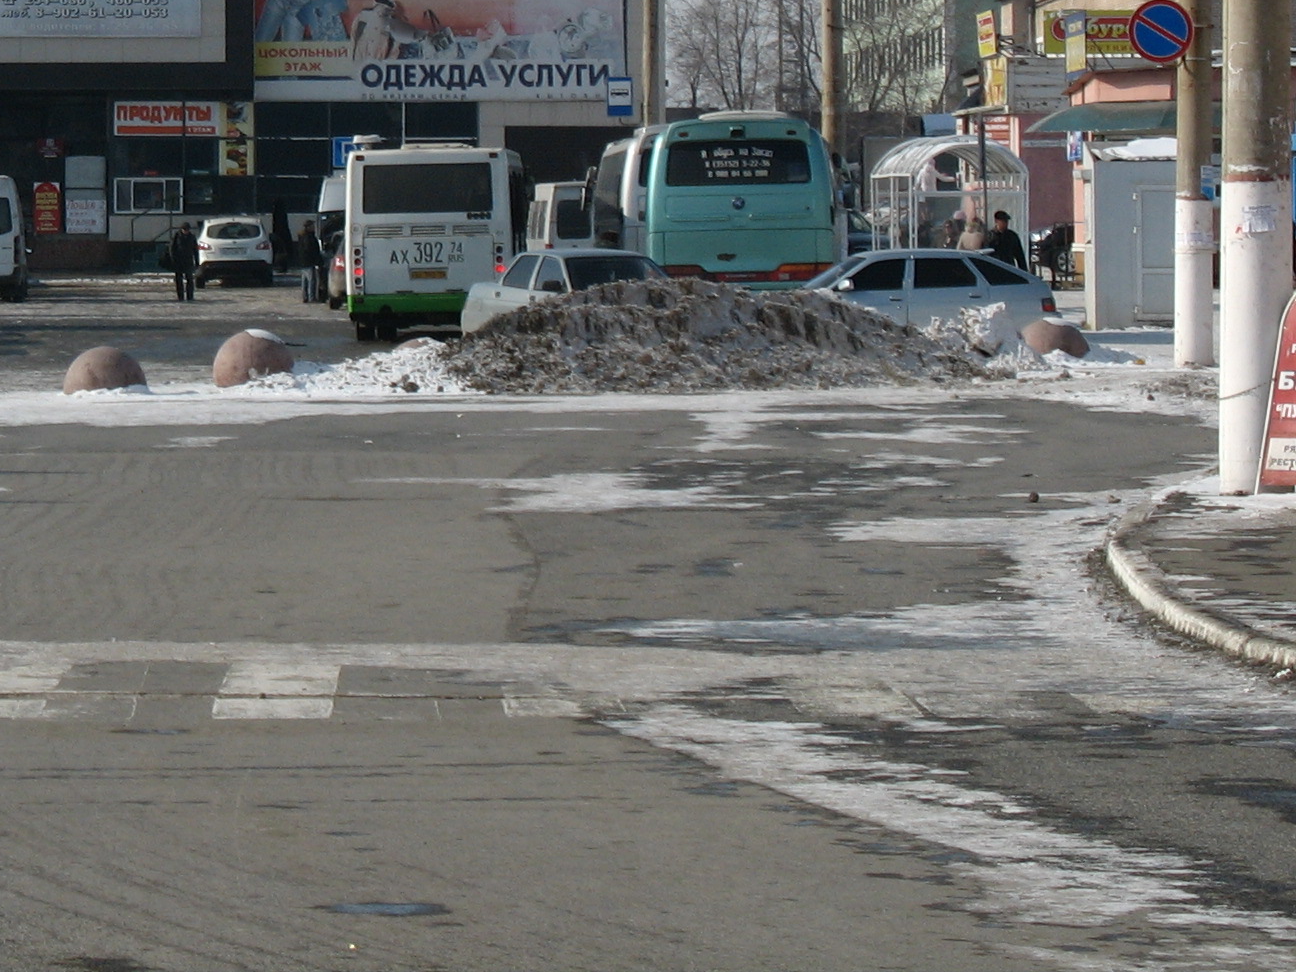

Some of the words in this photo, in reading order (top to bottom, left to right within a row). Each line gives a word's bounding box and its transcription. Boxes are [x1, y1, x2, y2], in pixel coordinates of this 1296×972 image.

[259, 46, 348, 61] ЦОКОЛЬНЫЙ
[284, 61, 323, 72] ЭТАЖ
[360, 63, 488, 91] ОДЕЖДА
[499, 63, 610, 88] УСЛУГИ
[116, 104, 212, 124] ПРОДУКТЫ
[389, 249, 410, 265] АХ
[413, 241, 443, 264] 392
[450, 241, 463, 254] 74
[447, 254, 465, 263] RUS
